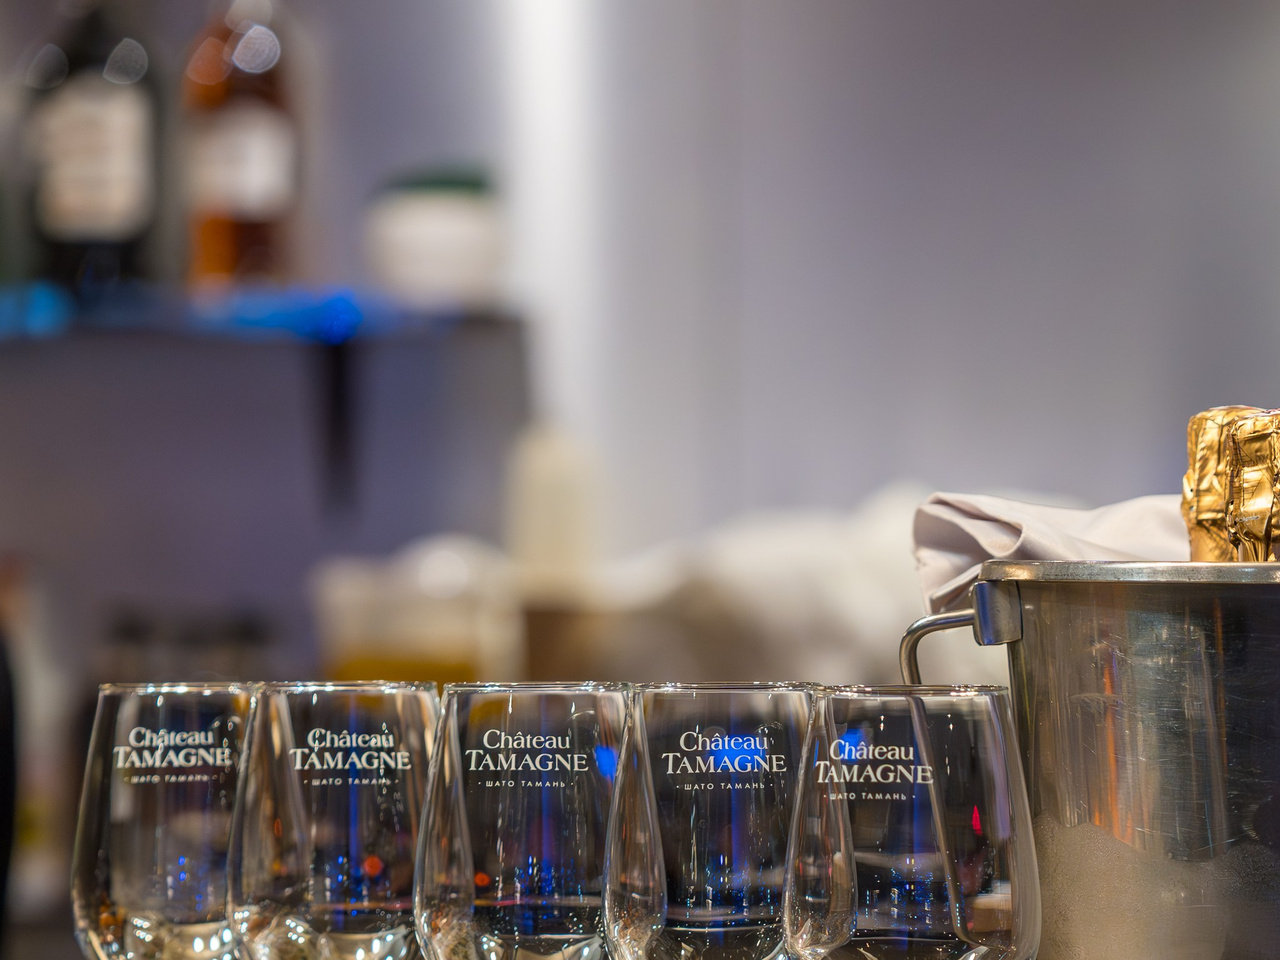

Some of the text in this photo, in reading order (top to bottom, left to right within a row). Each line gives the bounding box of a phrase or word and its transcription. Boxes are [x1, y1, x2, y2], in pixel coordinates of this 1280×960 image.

[128, 726, 214, 748] Château
[307, 727, 395, 748] Château
[482, 728, 570, 749] Château
[679, 731, 768, 751] Château
[113, 746, 233, 769] TAMAGNE
[289, 748, 412, 770] TAMAGNE
[465, 749, 589, 771] TAMAGNE
[829, 739, 914, 760] Château
[661, 752, 787, 774] TAMAGNE
[815, 761, 934, 784] TAMAGNE
[829, 792, 907, 800] ШАТО ТАМАНЬ
